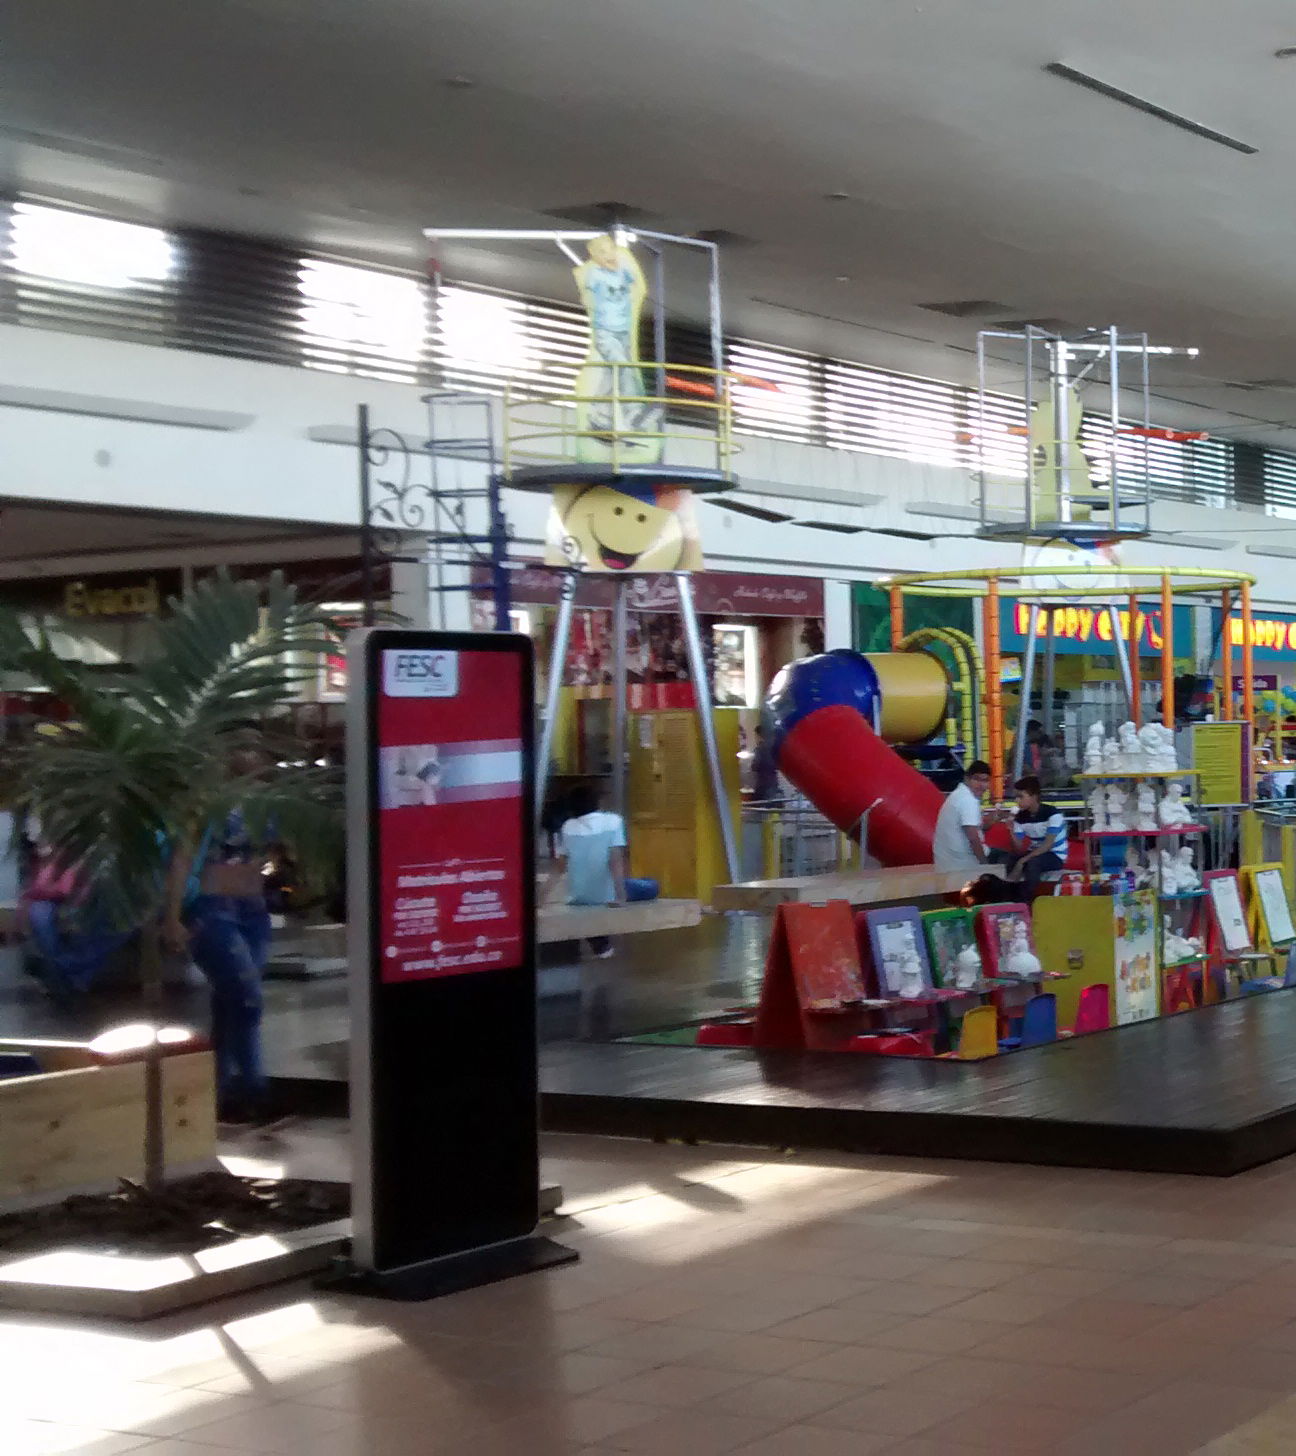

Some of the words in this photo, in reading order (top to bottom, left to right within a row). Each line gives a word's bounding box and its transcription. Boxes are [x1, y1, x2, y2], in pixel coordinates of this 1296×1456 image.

[1014, 603, 1094, 642] HAPPY
[1094, 610, 1145, 641] CTY
[394, 654, 446, 677] FESC
